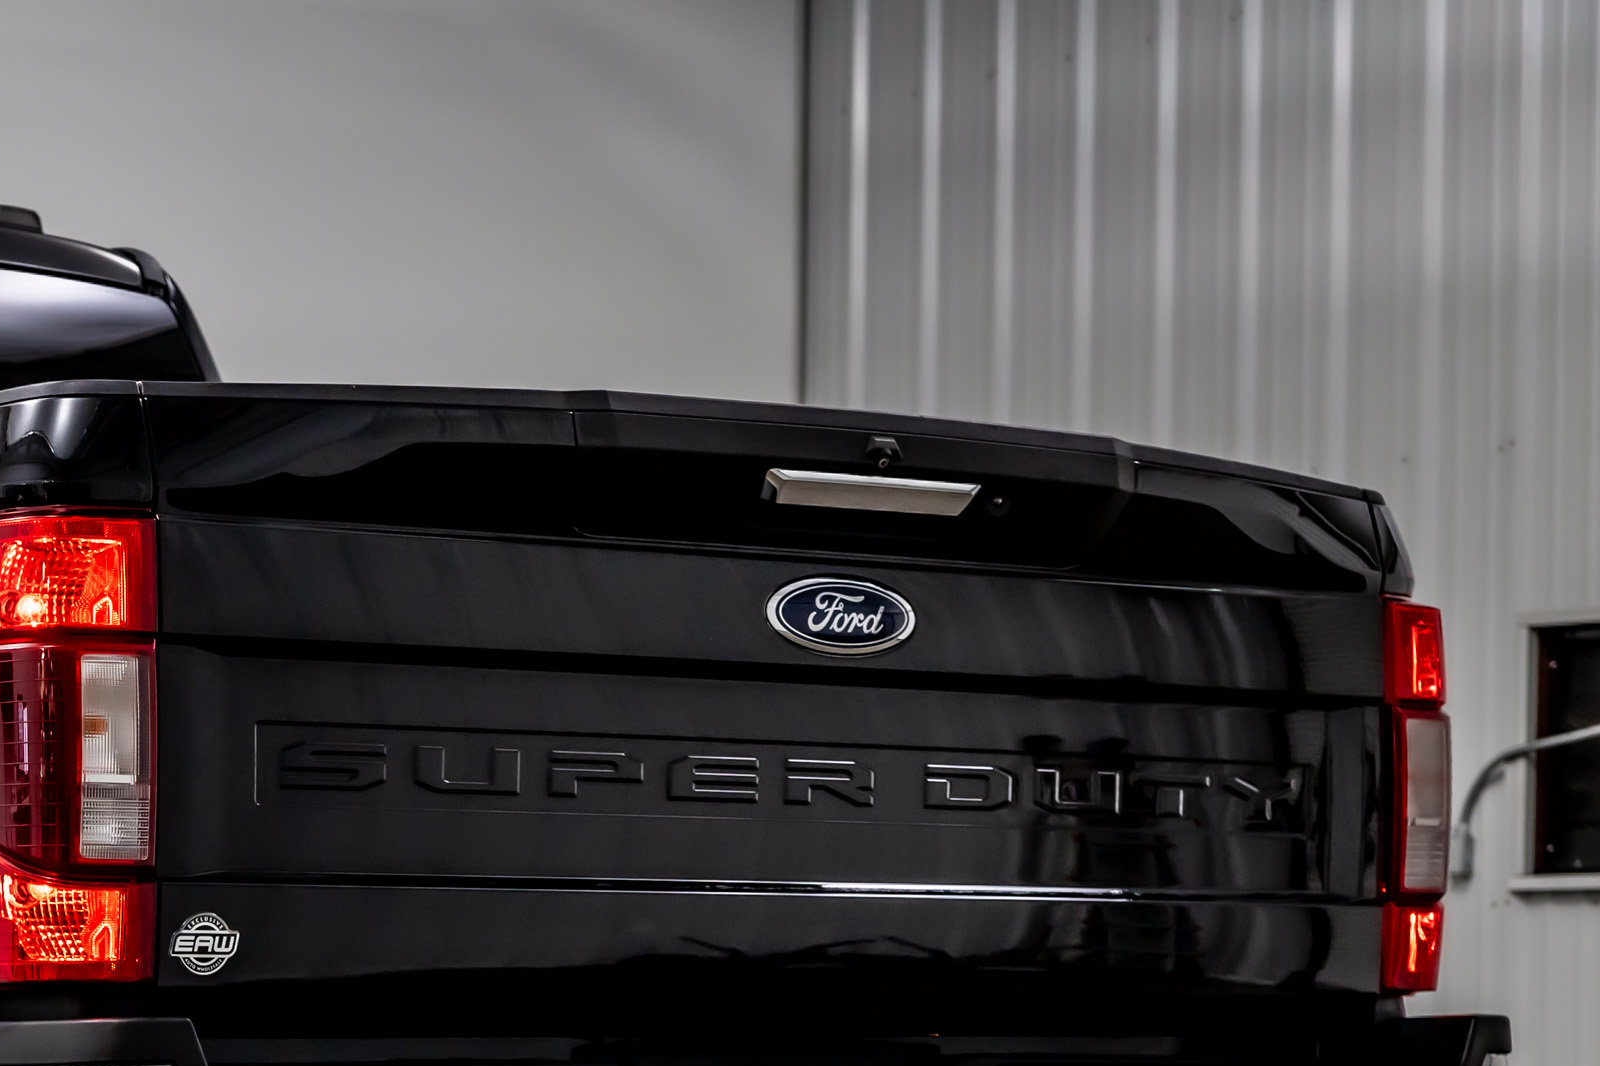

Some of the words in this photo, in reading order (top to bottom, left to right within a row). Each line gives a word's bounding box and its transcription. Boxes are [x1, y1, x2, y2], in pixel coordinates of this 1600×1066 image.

[807, 591, 884, 634] Ford
[279, 741, 875, 807] SUPER
[923, 763, 1297, 822] DUTY
[186, 915, 224, 930] EXCLUSIVE
[174, 935, 235, 952] EAW
[185, 958, 197, 970] AUTO
